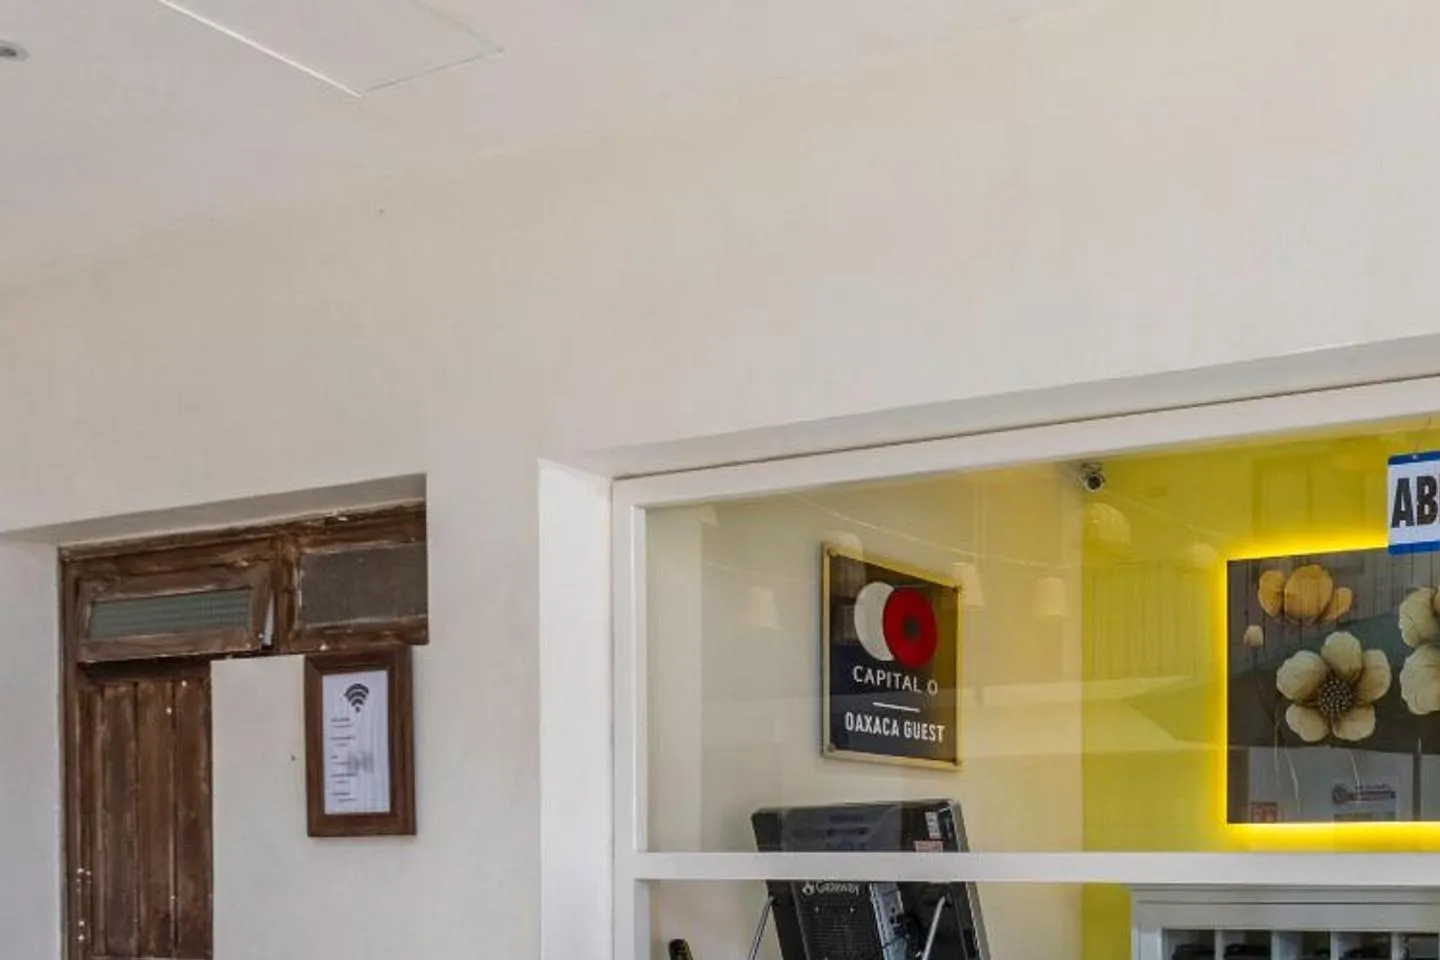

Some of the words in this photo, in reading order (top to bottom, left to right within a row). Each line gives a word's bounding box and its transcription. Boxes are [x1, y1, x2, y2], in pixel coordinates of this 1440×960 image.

[853, 665, 922, 694] CAPITAL
[927, 679, 938, 696] O
[845, 711, 900, 737] OAXACA
[903, 720, 945, 743] GUEST
